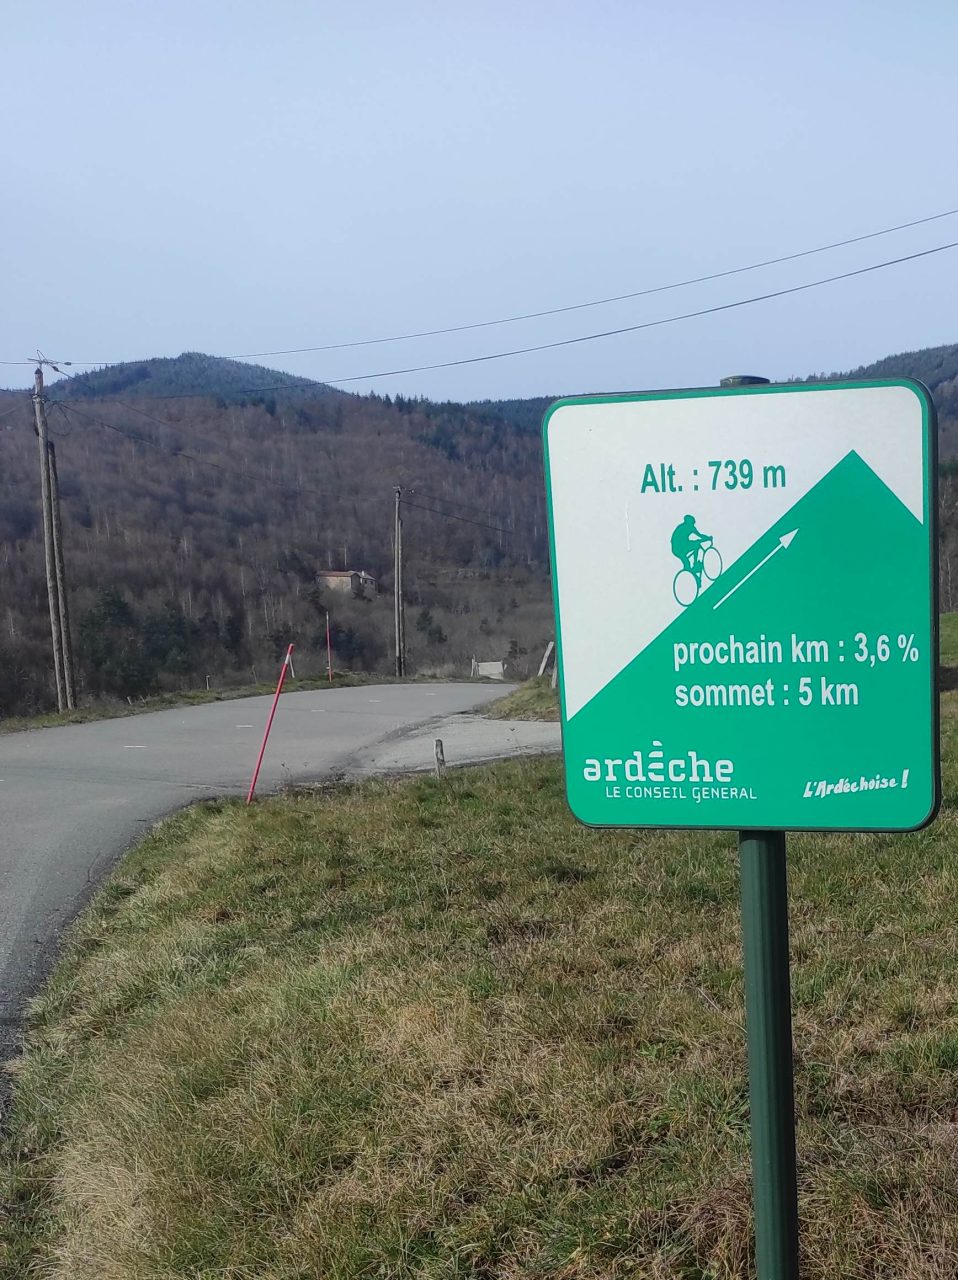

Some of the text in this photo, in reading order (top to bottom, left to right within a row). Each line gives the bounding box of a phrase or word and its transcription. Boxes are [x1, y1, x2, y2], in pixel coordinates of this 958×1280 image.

[641, 463, 683, 493] Alt.
[708, 459, 753, 490] 739
[764, 464, 786, 487] m
[674, 635, 783, 671] prochain
[791, 634, 829, 663] km
[854, 633, 890, 667] 3,6
[898, 635, 919, 662] %
[675, 679, 775, 707] sommet
[799, 679, 813, 705] 5
[820, 676, 858, 705] km
[606, 786, 621, 798] LE
[626, 786, 686, 799] CONSEIL
